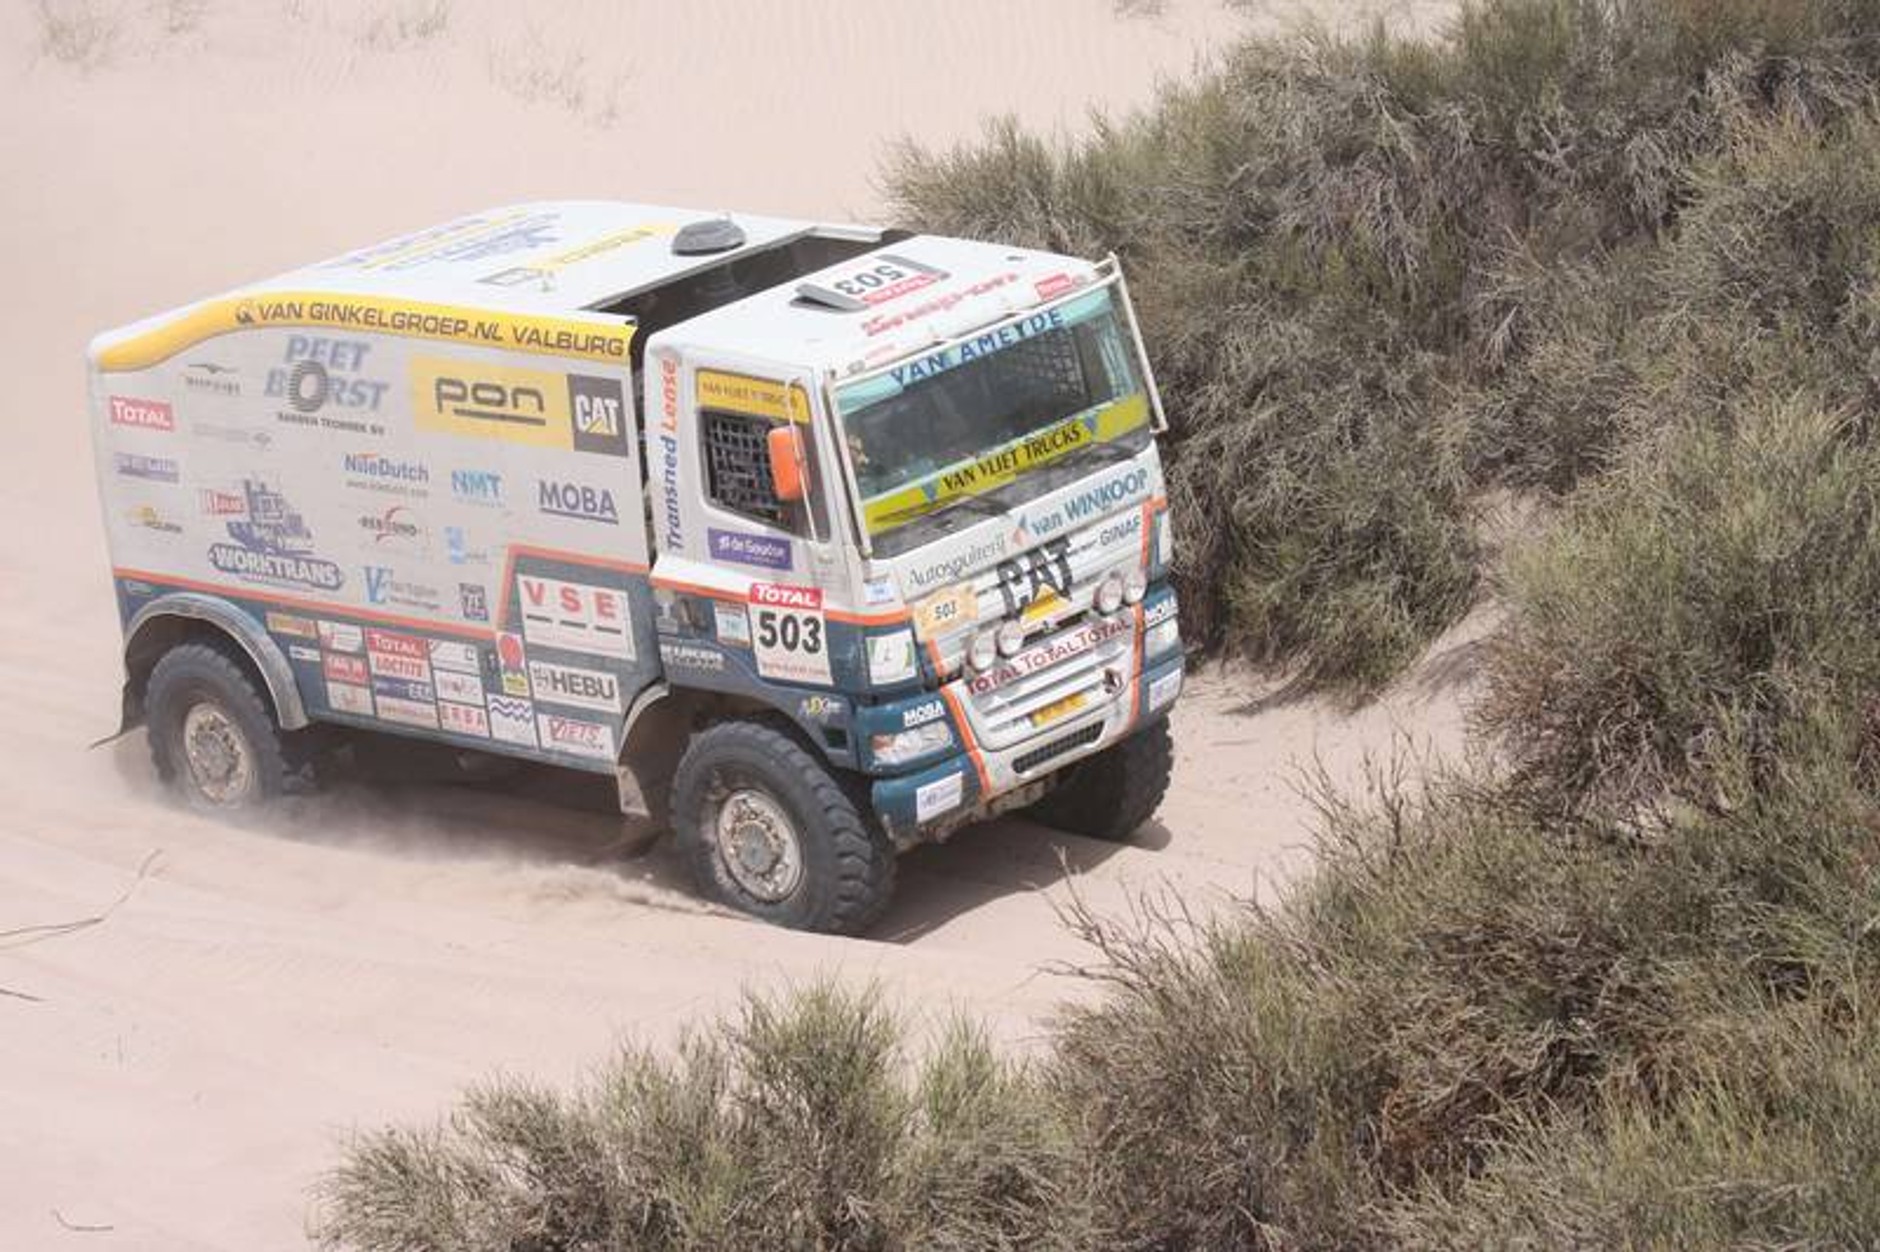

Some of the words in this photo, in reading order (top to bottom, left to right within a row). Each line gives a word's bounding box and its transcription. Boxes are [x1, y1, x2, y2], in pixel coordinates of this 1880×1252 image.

[834, 264, 904, 296] 503
[258, 302, 303, 321] VAN
[308, 303, 504, 342] GINKELGROEP.NL
[512, 325, 624, 357] VALBURG
[890, 353, 946, 385] VAN
[959, 308, 1064, 361] AMEYDE
[284, 335, 371, 372] PEET
[112, 399, 171, 428] TOTAL
[435, 377, 546, 415] pon
[661, 359, 677, 433] Lease
[575, 394, 620, 437] CAT
[344, 453, 429, 483] NileDutch
[942, 466, 976, 491] VAN
[978, 450, 1021, 475] VLIET
[1023, 424, 1081, 462] TRUCKS
[451, 469, 503, 498] NMT
[539, 479, 619, 517] MOBA
[1031, 511, 1063, 536] van
[1064, 467, 1148, 521] WINKOOP
[1099, 514, 1142, 546] GINAF
[755, 583, 817, 605] TOTAL
[373, 632, 421, 656] TOTAL
[758, 611, 822, 655] 503
[1020, 639, 1082, 670] TOTAL
[1074, 618, 1131, 646] TOTAL
[550, 670, 615, 700] HEBU
[902, 699, 945, 728] MOBA
